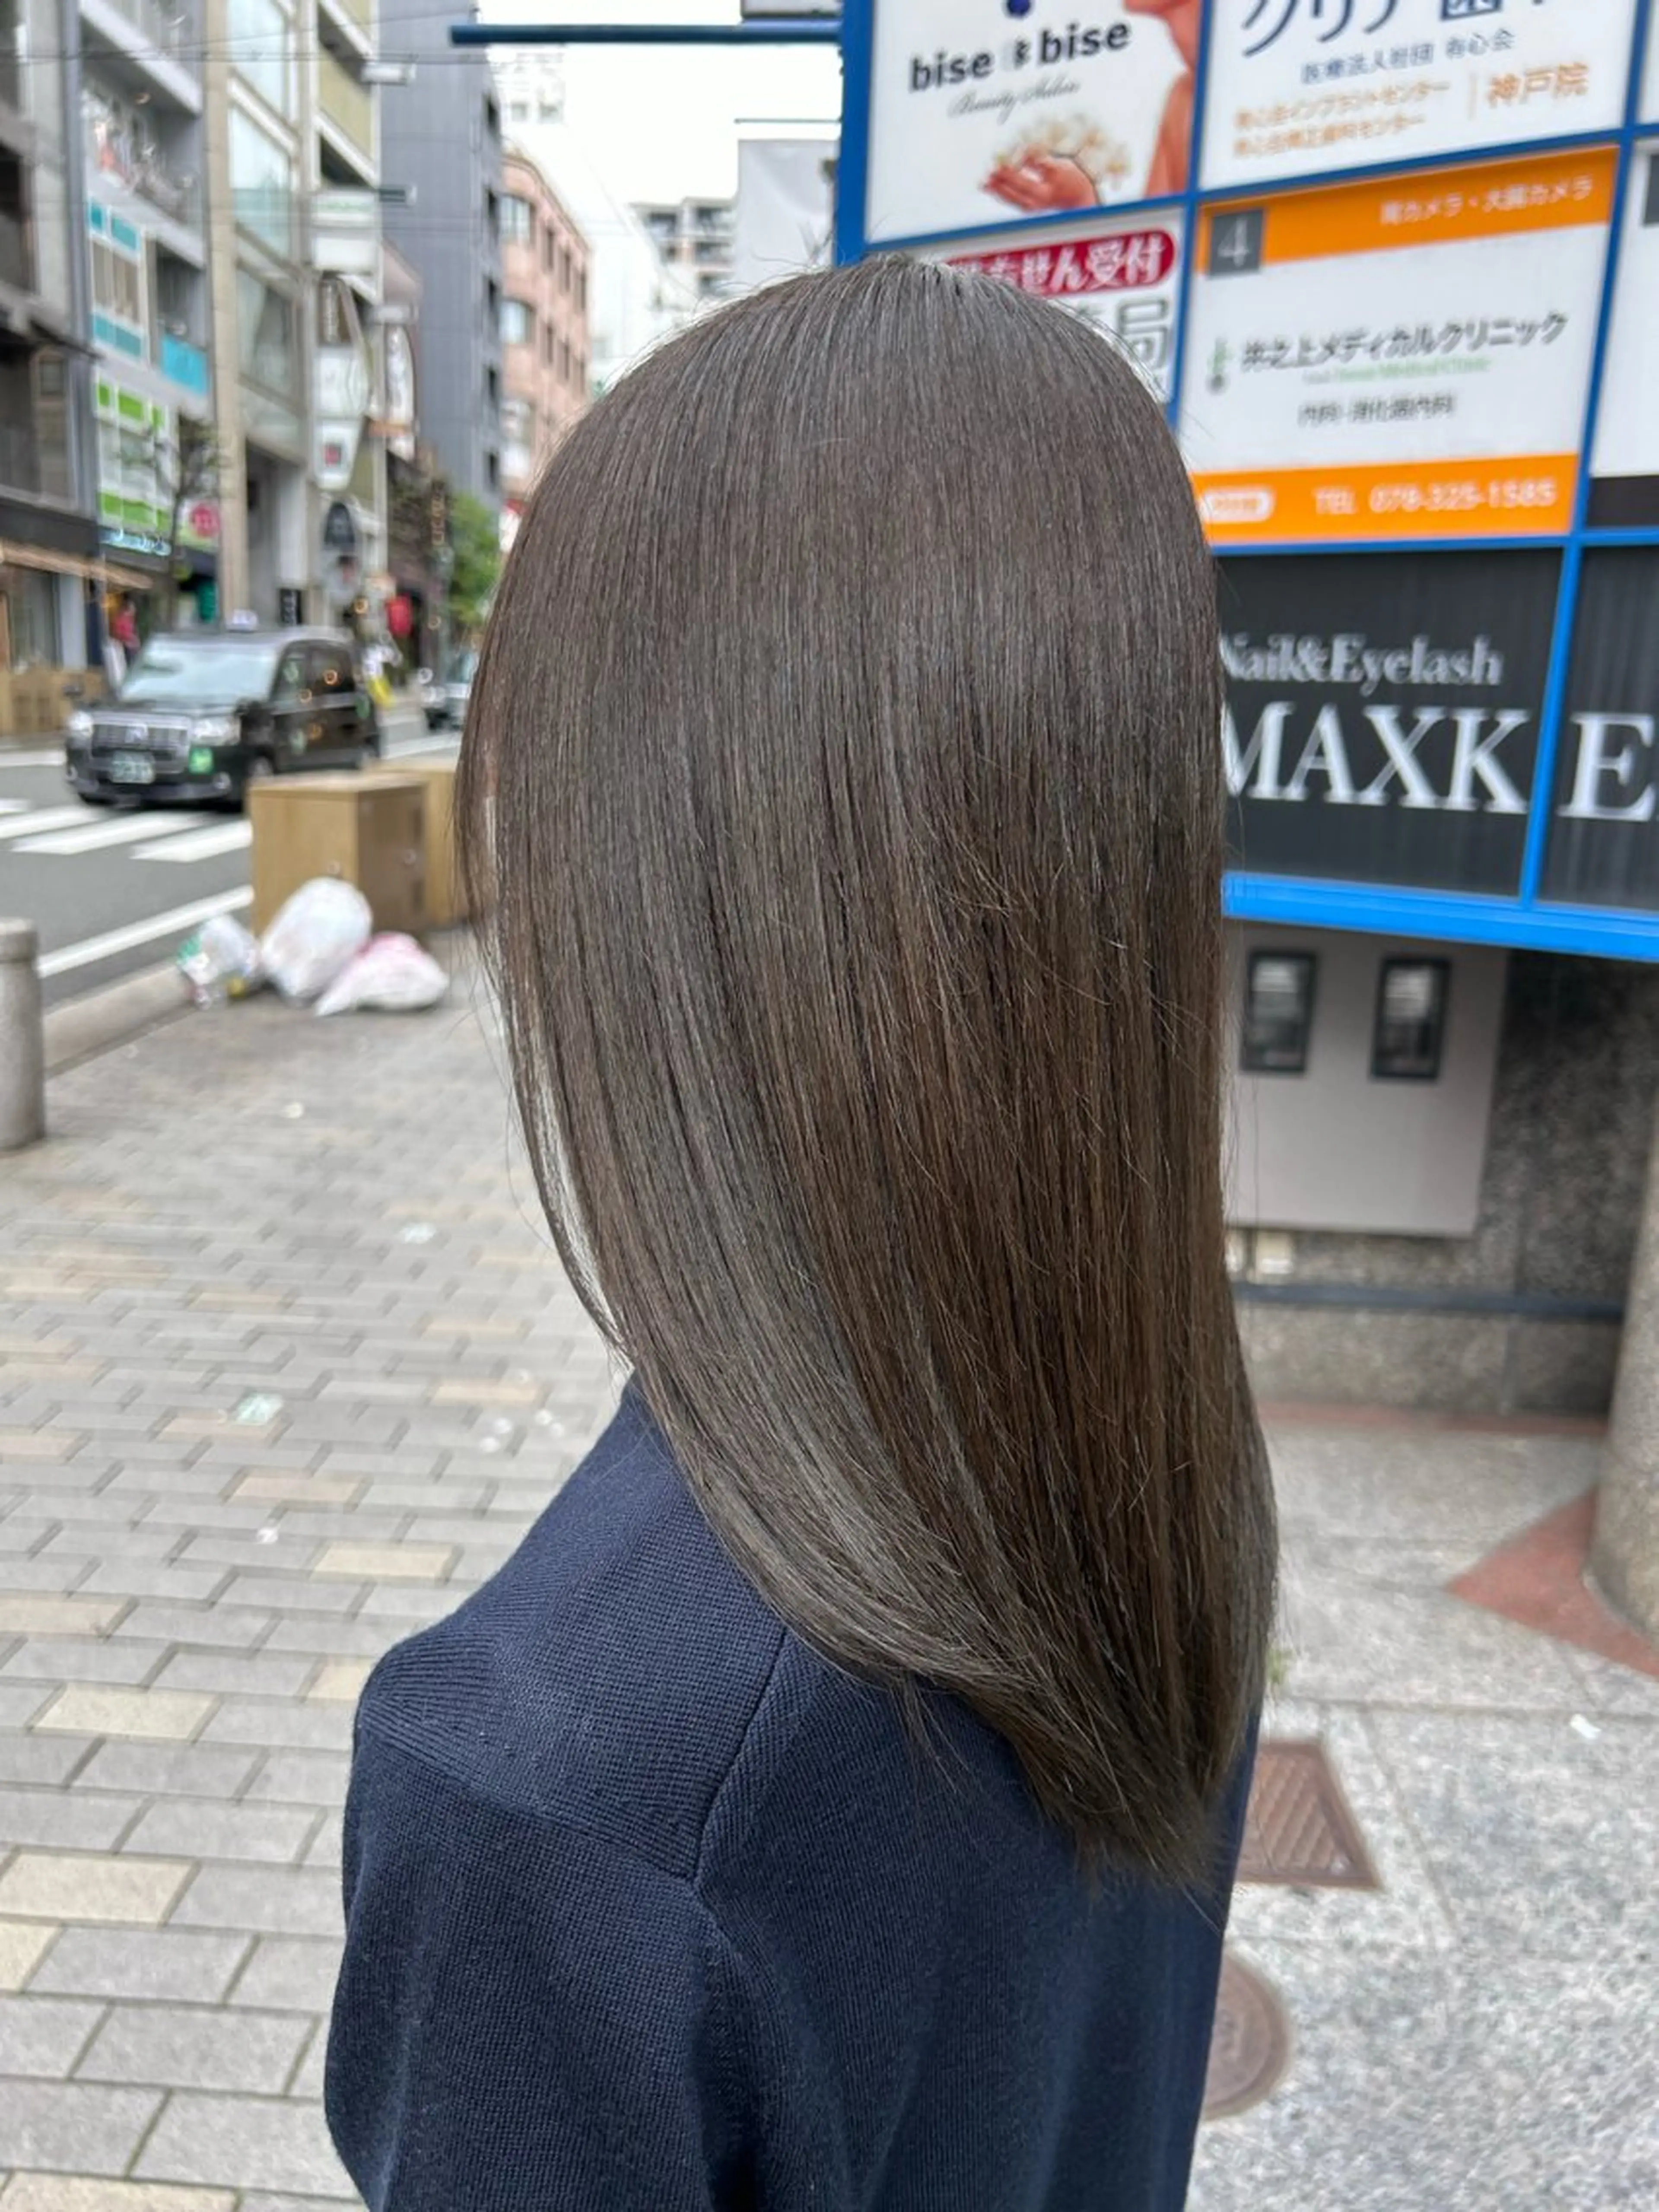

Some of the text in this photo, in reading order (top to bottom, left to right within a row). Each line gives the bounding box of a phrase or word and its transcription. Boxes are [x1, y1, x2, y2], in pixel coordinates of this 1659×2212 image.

[909, 50, 993, 92] bise
[1039, 22, 1131, 64] bise
[1487, 62, 1589, 109] 神戸院
[1217, 217, 1249, 268] 4
[1313, 486, 1357, 515] TEL
[1219, 632, 1503, 696] Nail&Eyelash
